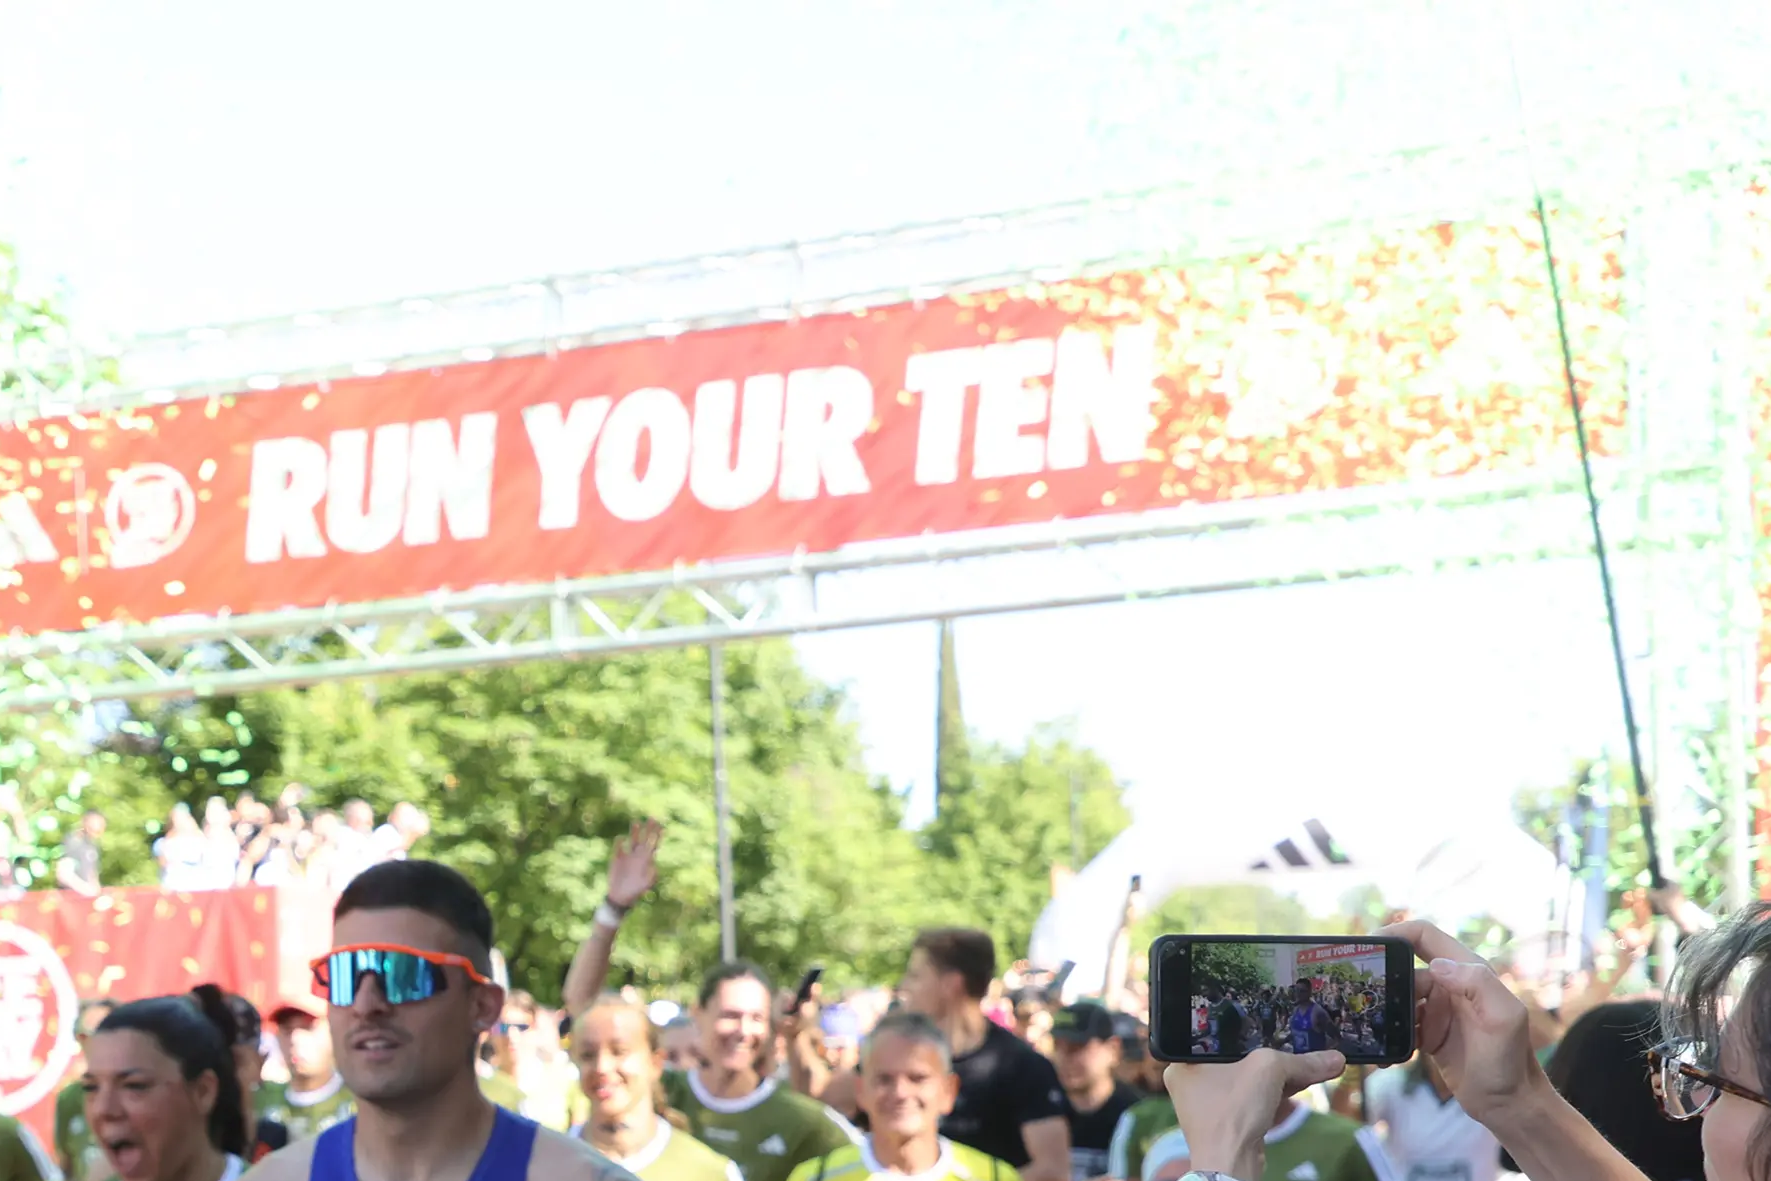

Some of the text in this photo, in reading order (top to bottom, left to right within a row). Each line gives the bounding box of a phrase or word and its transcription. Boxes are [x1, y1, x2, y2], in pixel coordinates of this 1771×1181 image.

[245, 321, 1155, 564] RUN YOUR TEN
[1333, 944, 1356, 956] YOUR
